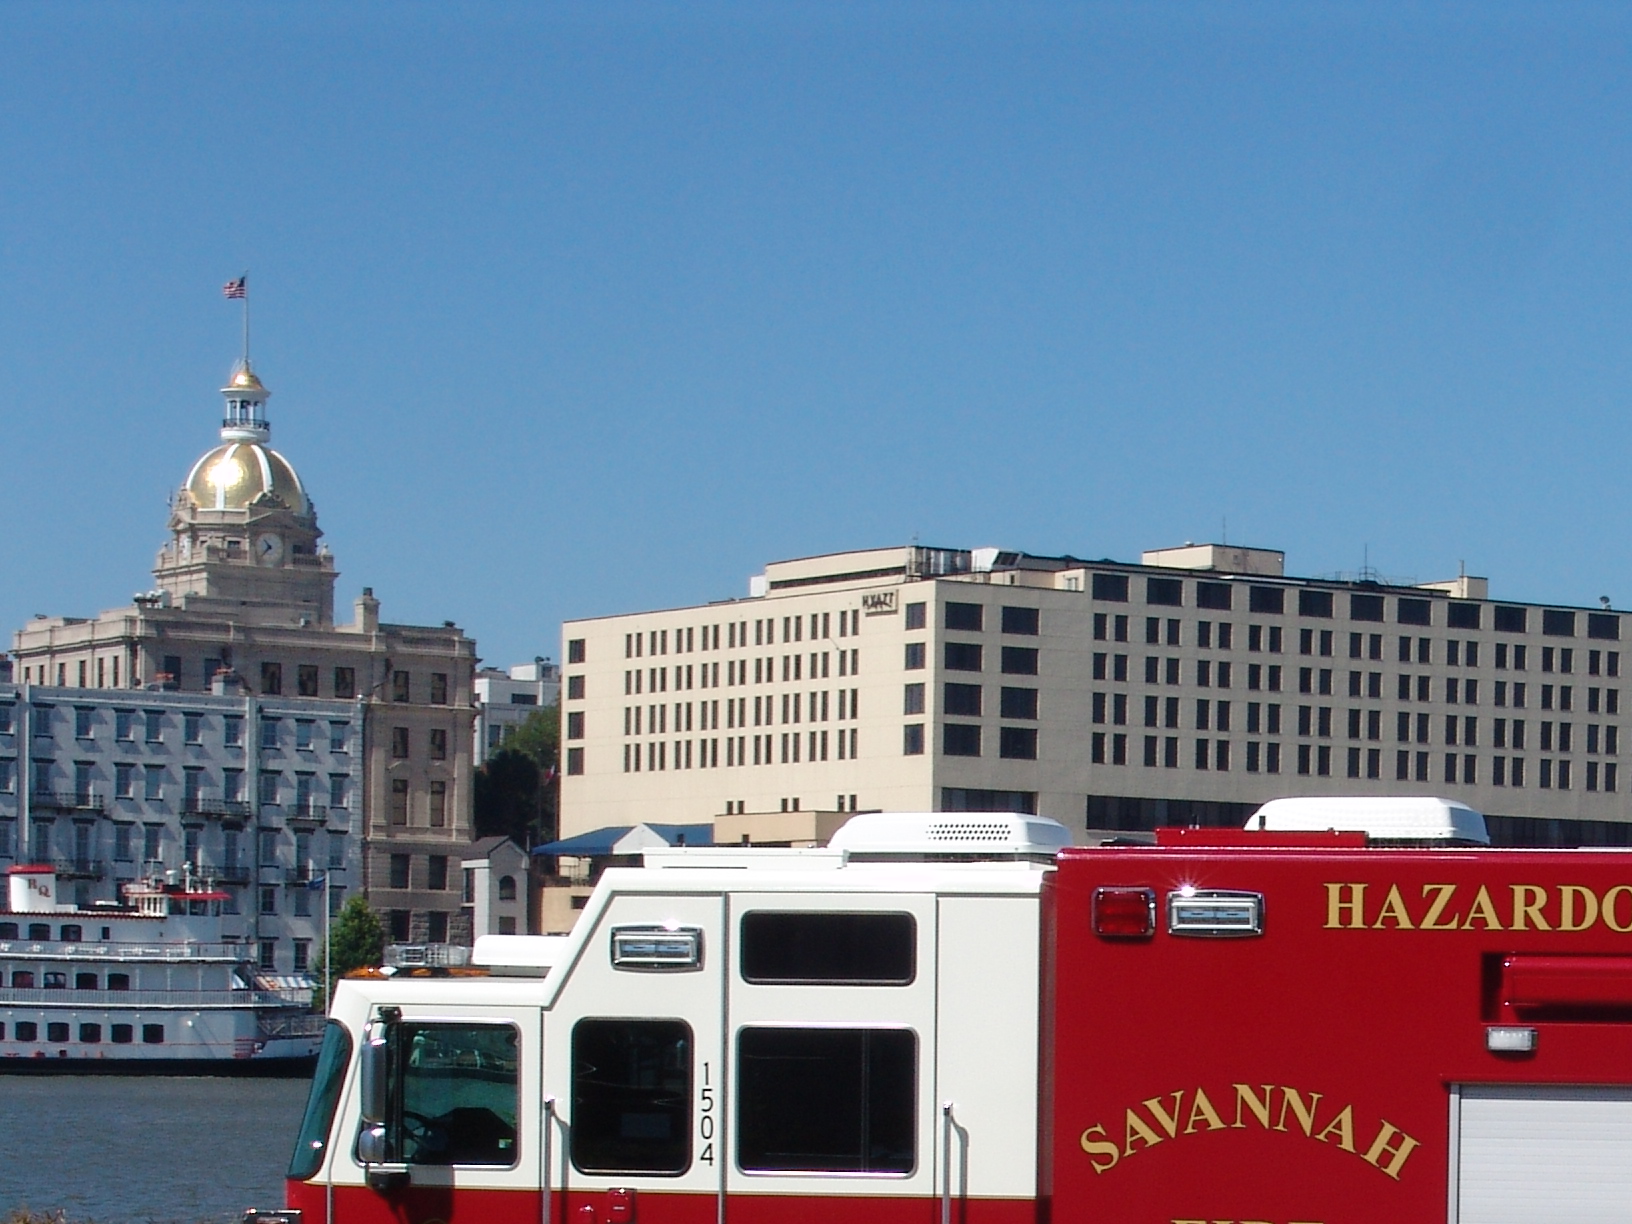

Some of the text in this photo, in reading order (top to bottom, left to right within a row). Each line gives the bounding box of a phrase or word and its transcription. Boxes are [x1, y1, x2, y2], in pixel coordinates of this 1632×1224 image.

[862, 592, 894, 608] HYATT
[700, 1062, 714, 1167] 1504
[1080, 1083, 1421, 1181] SAVANNAH
